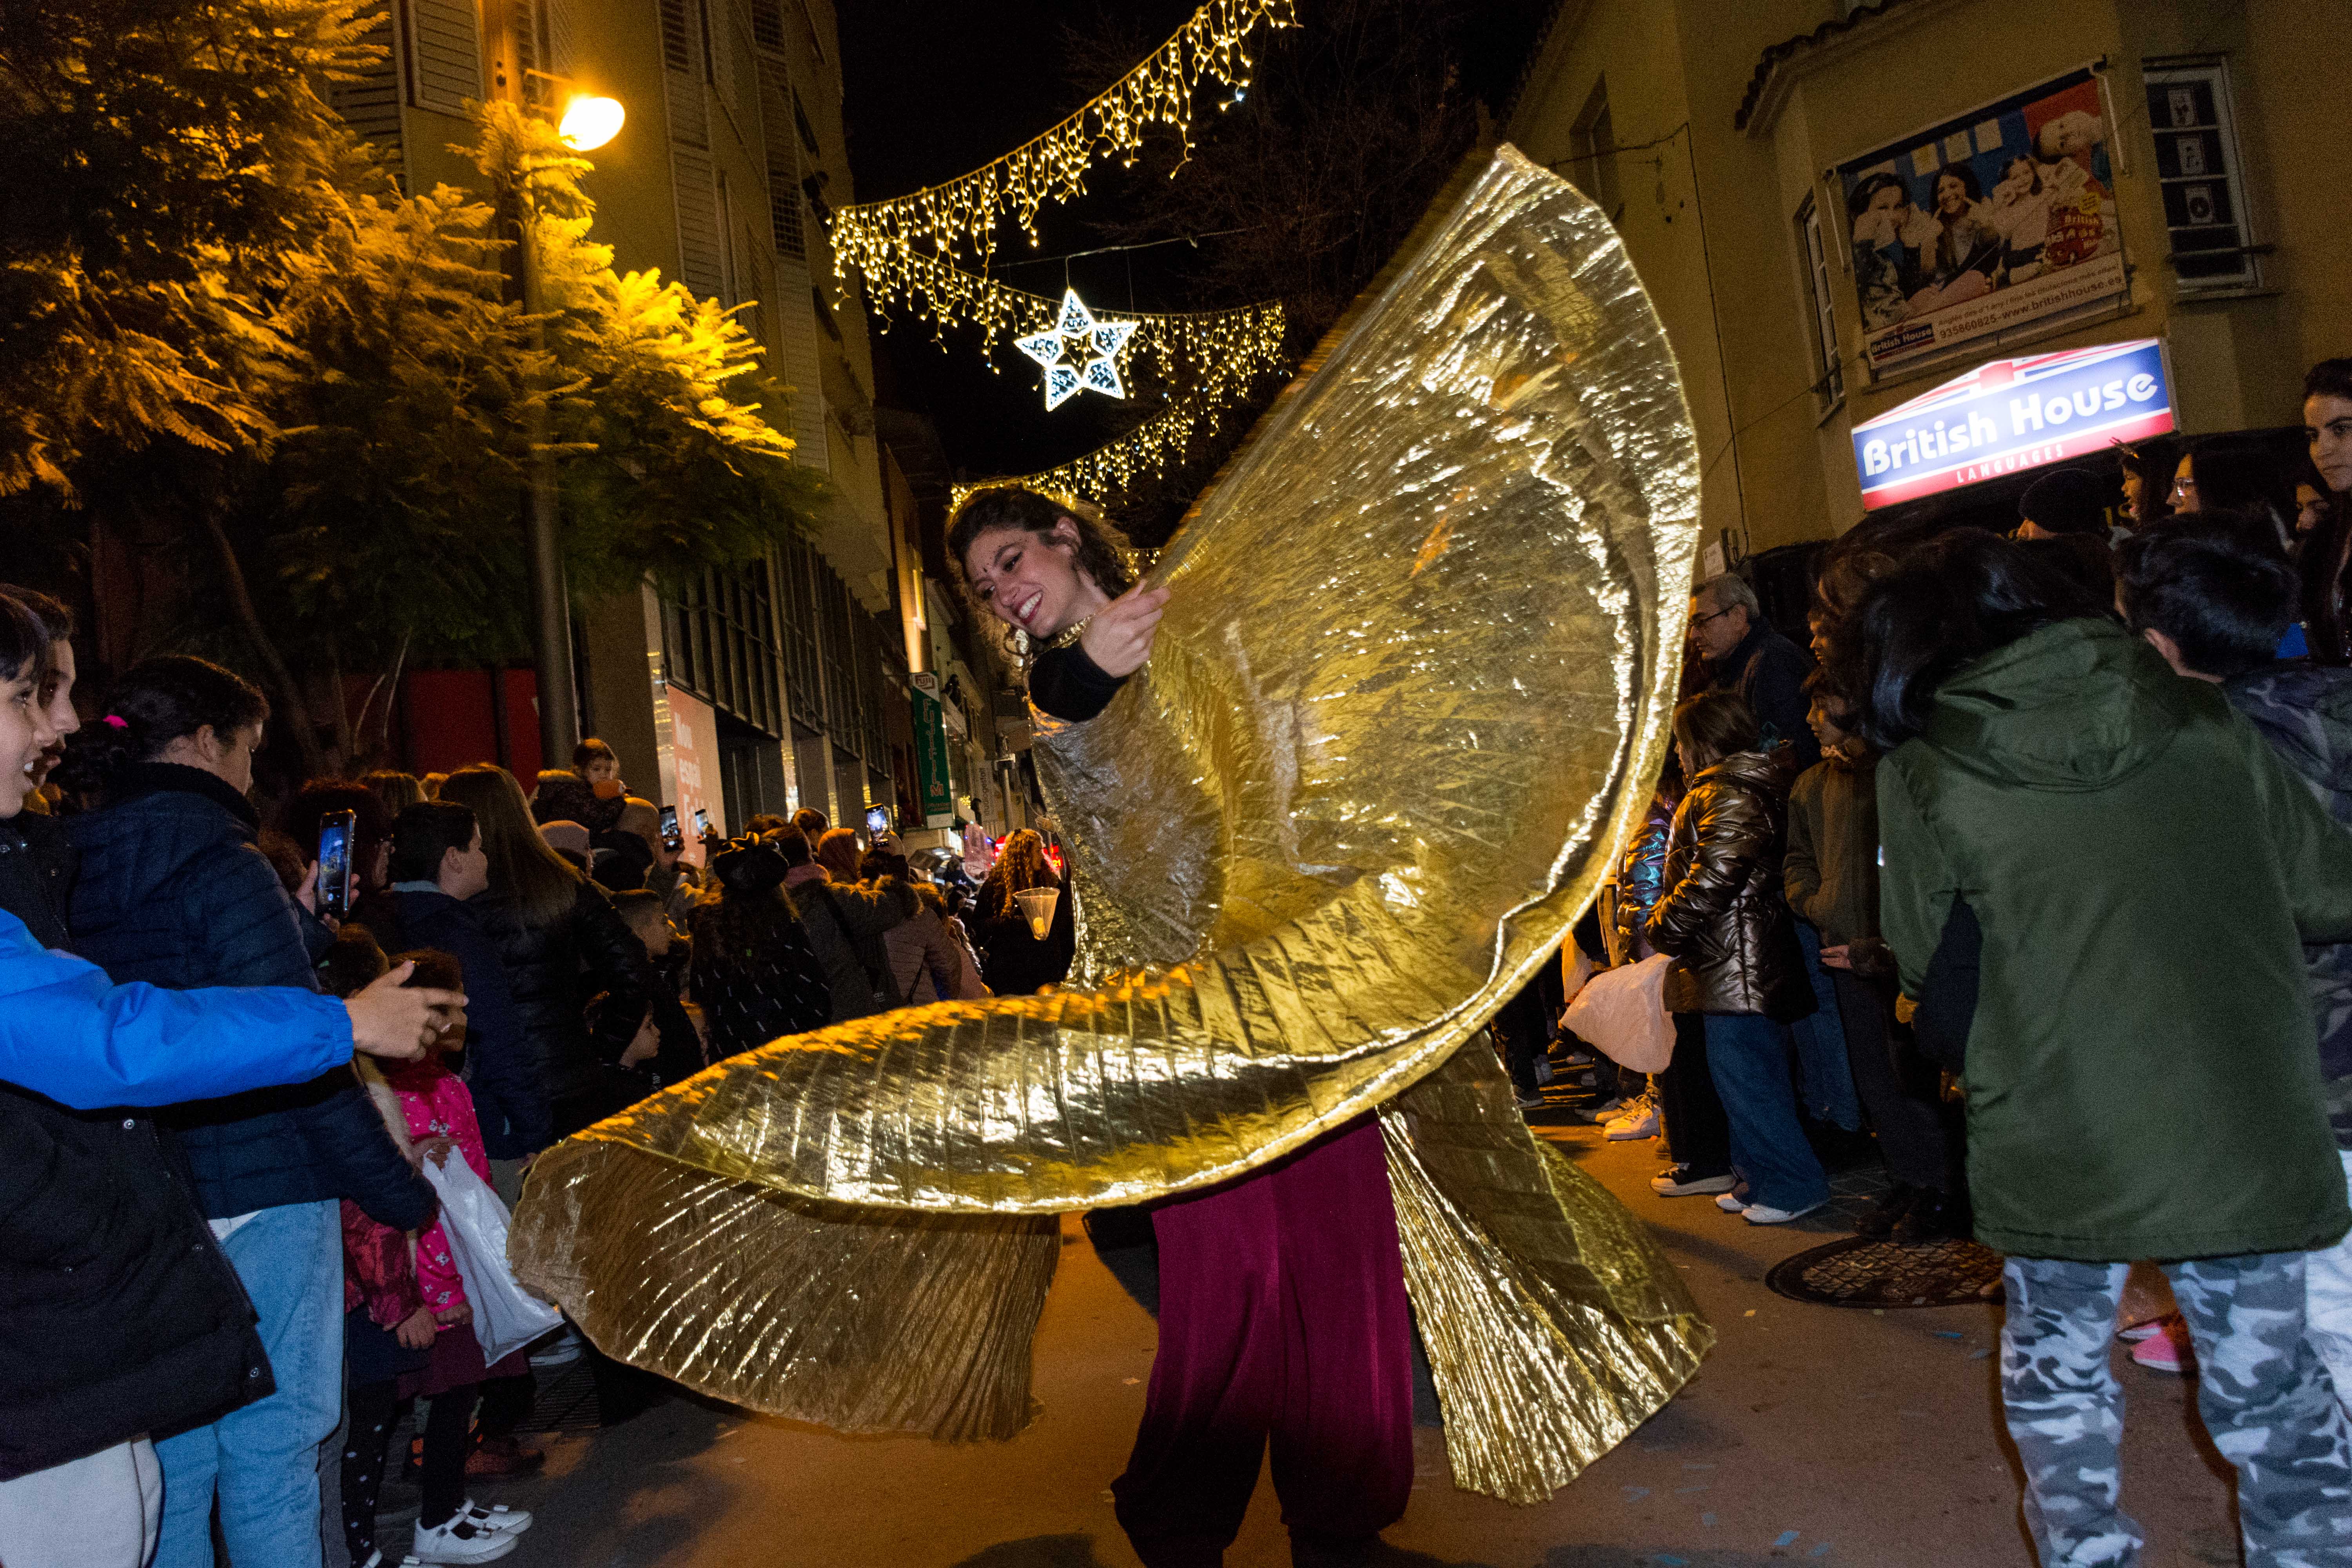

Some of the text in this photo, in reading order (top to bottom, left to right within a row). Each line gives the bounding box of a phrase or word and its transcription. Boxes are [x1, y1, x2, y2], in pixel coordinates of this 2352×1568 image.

[1863, 372, 2158, 476] British House
[1957, 444, 2064, 484] LANGUAGES
[923, 698, 944, 797] FUJIFILM
